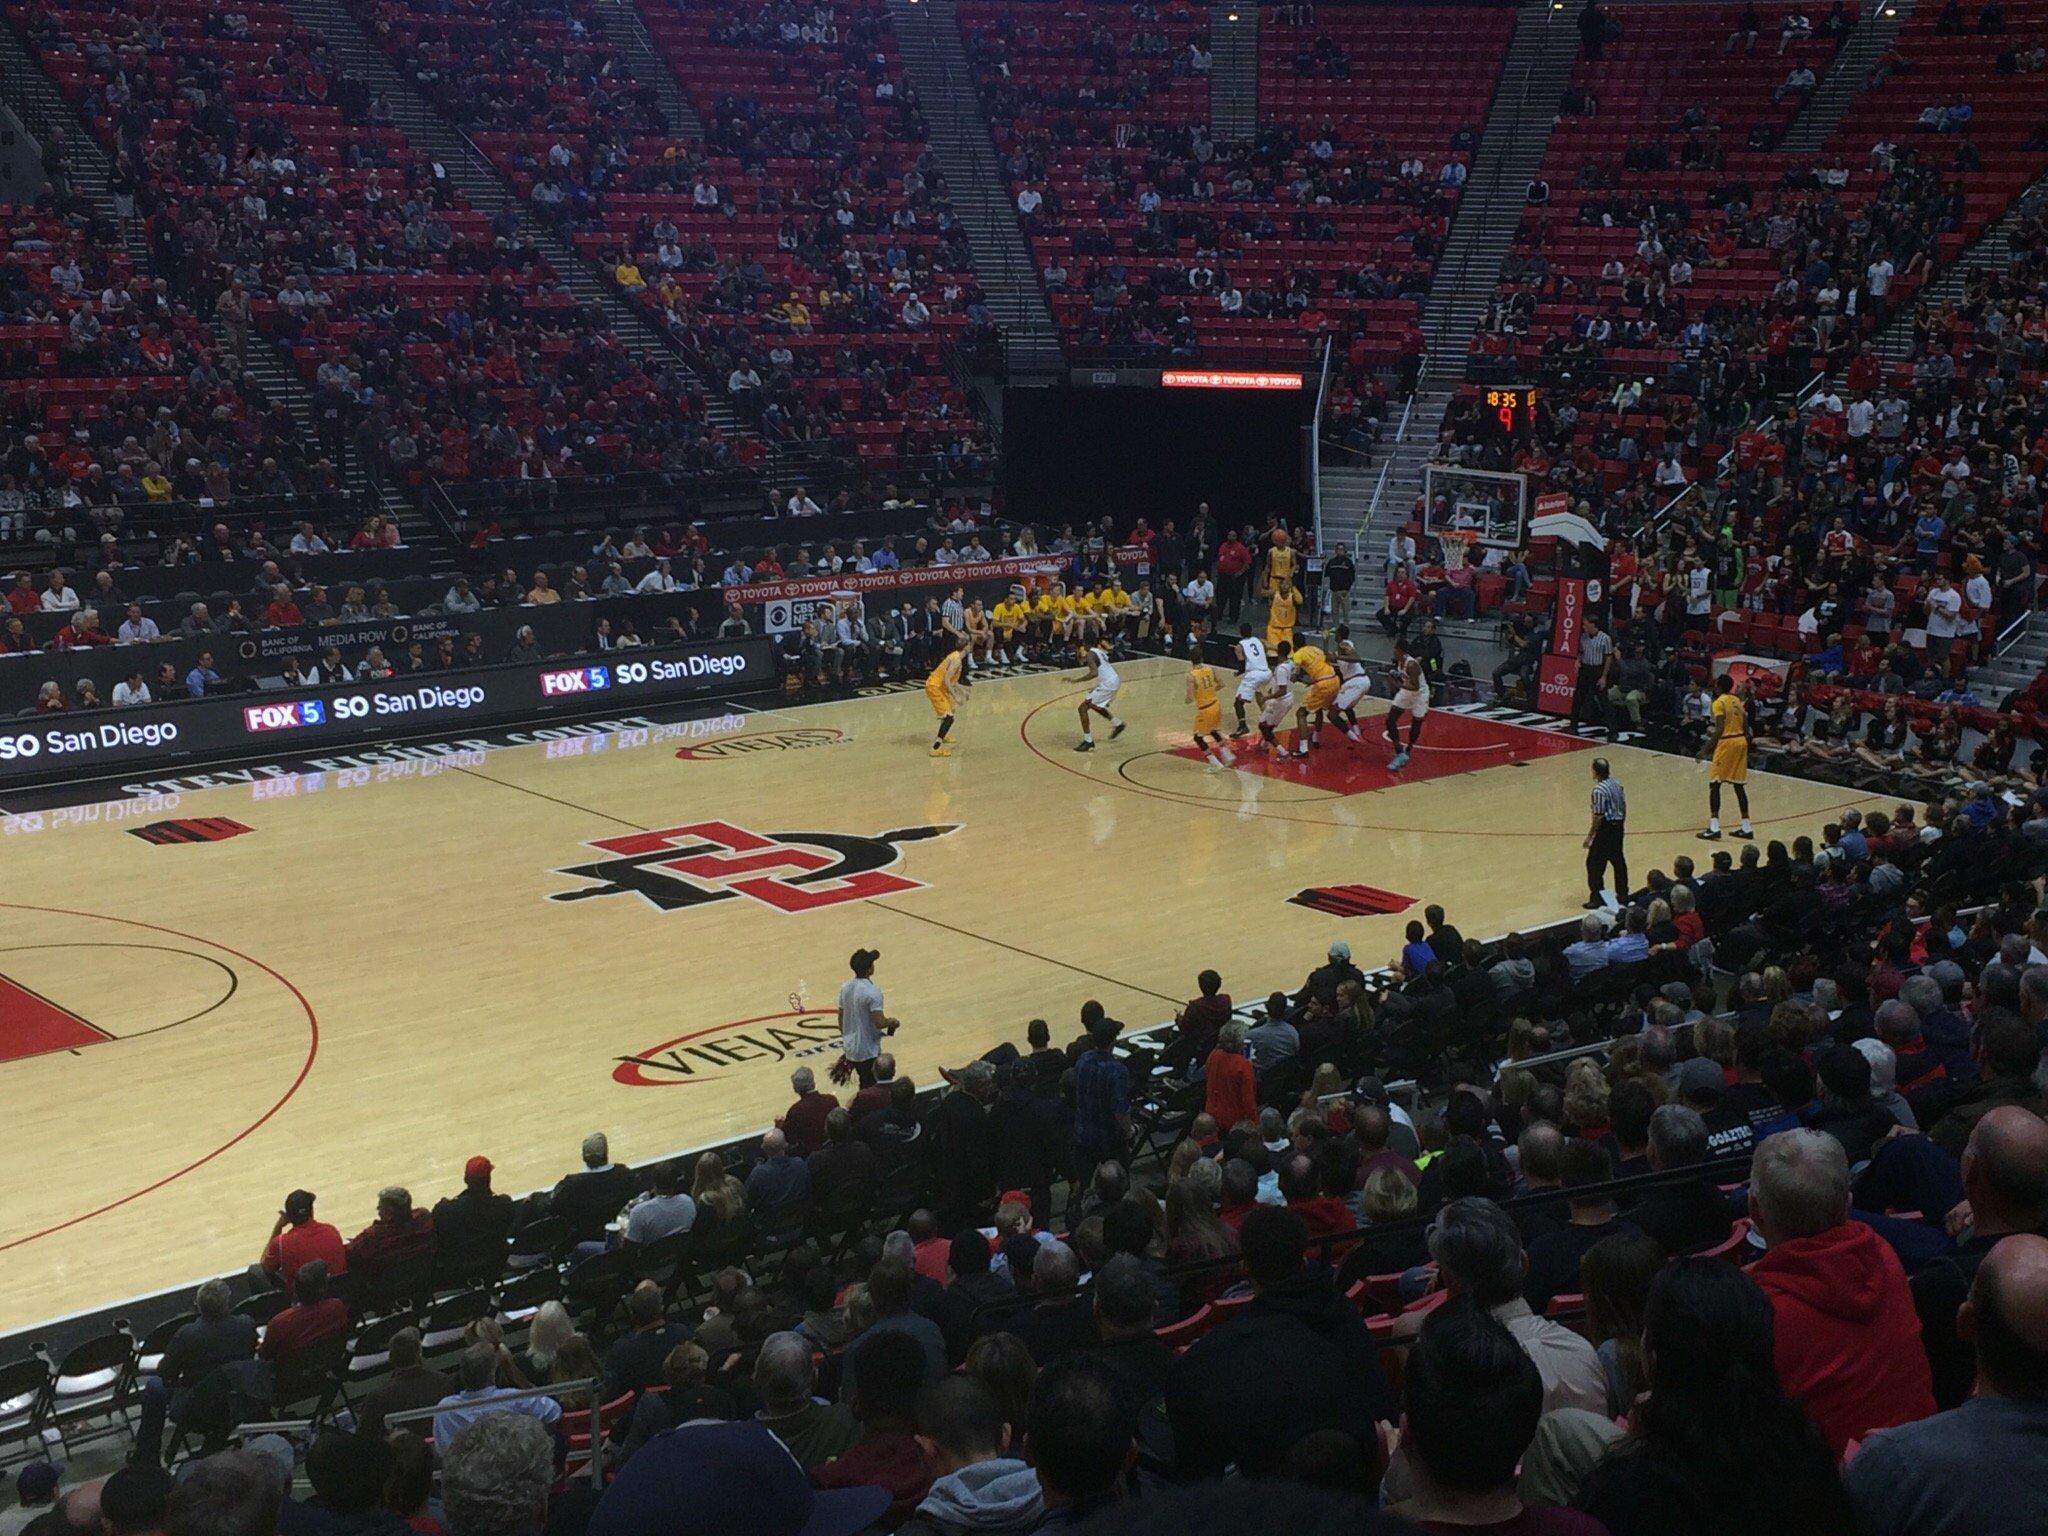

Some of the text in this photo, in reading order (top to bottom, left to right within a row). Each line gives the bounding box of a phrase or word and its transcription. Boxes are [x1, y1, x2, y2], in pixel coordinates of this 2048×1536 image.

[1176, 375, 1303, 386] TOYOTA TOYOTA TOYOTA
[1487, 391, 1517, 408] 18:35
[1499, 407, 1511, 432] 9
[1116, 550, 1149, 561] TOYOTA
[741, 587, 782, 599] TOYOTA
[800, 580, 840, 593] TOYOTA
[858, 575, 896, 588] TOYOTA
[912, 570, 950, 582] TOYOTA
[965, 565, 1002, 577] TOYOTA
[793, 602, 815, 615] CBS
[1560, 582, 1576, 653] TOYOTA
[412, 621, 448, 632] BANC OF
[412, 629, 460, 640] CALIFORNIA
[261, 635, 299, 647] BANC OF
[318, 630, 388, 647] MEDIA ROW
[261, 644, 313, 657] CALIFORNIA
[1249, 643, 1260, 657] 3
[543, 654, 746, 694] FOX 5 SO San Diego
[1540, 681, 1576, 698] TOYOT
[248, 686, 485, 730] FOX 5 SO San Diego
[0, 721, 178, 760] SO San Diego
[692, 731, 831, 756] VIEJAS
[121, 764, 298, 798] STEVE
[303, 738, 506, 772] FISHER
[506, 716, 662, 746] COURT
[612, 1017, 843, 1075] VIEJAS
